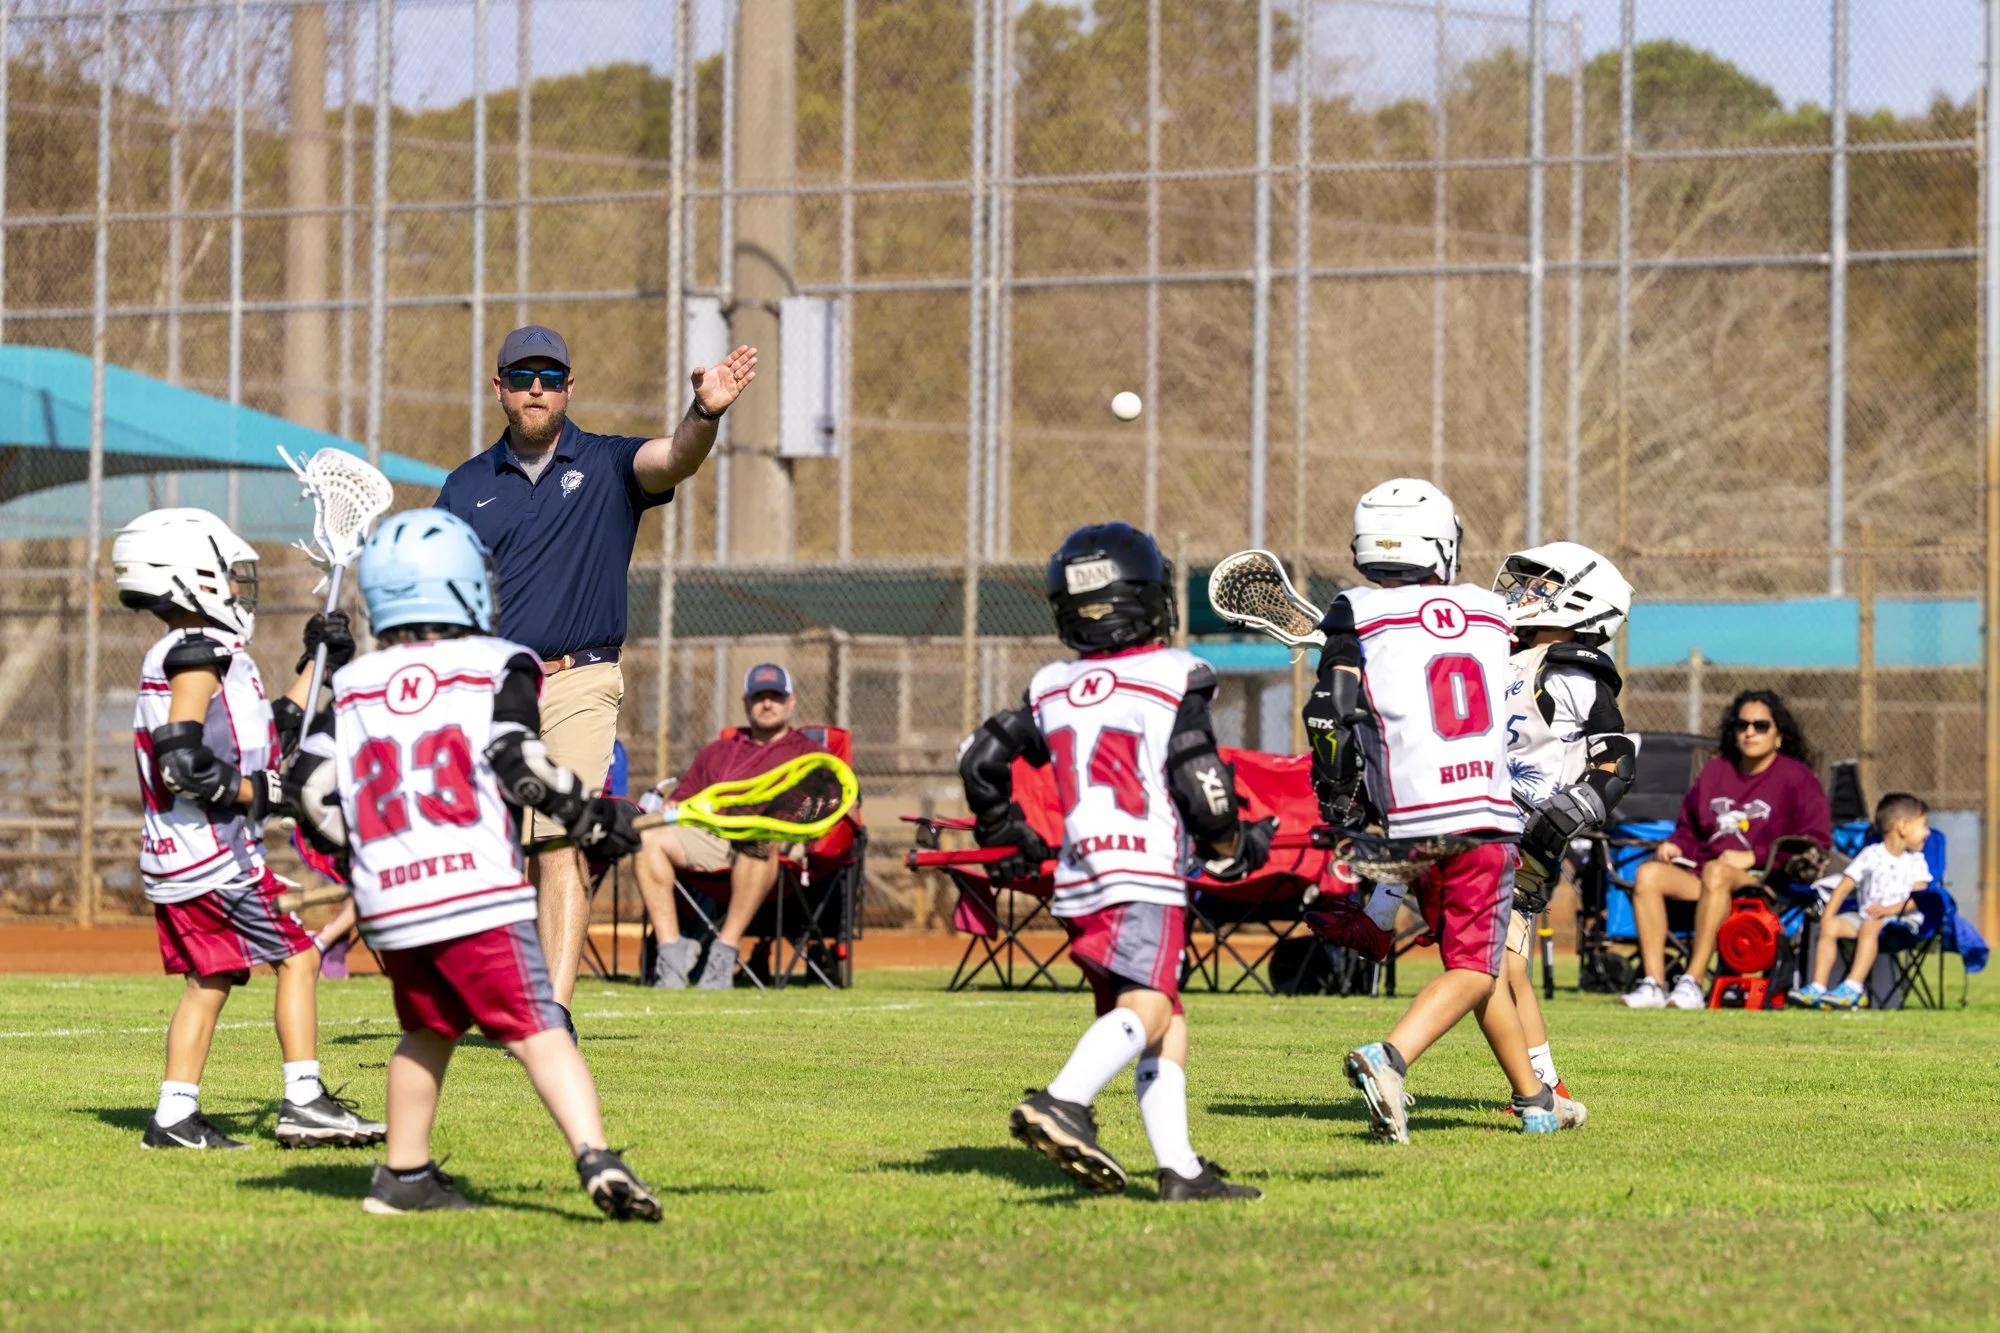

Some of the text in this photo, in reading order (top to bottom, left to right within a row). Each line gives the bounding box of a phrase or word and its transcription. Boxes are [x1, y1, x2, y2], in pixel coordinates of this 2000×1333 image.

[1433, 609, 1455, 629] N
[1577, 650, 1598, 660] STX
[400, 677, 421, 701] N
[1080, 677, 1102, 697] N
[1424, 653, 1494, 741] 0
[1308, 716, 1334, 730] STX
[353, 724, 483, 845] 23
[1195, 767, 1229, 816] STX
[378, 852, 477, 890] HOOVER
